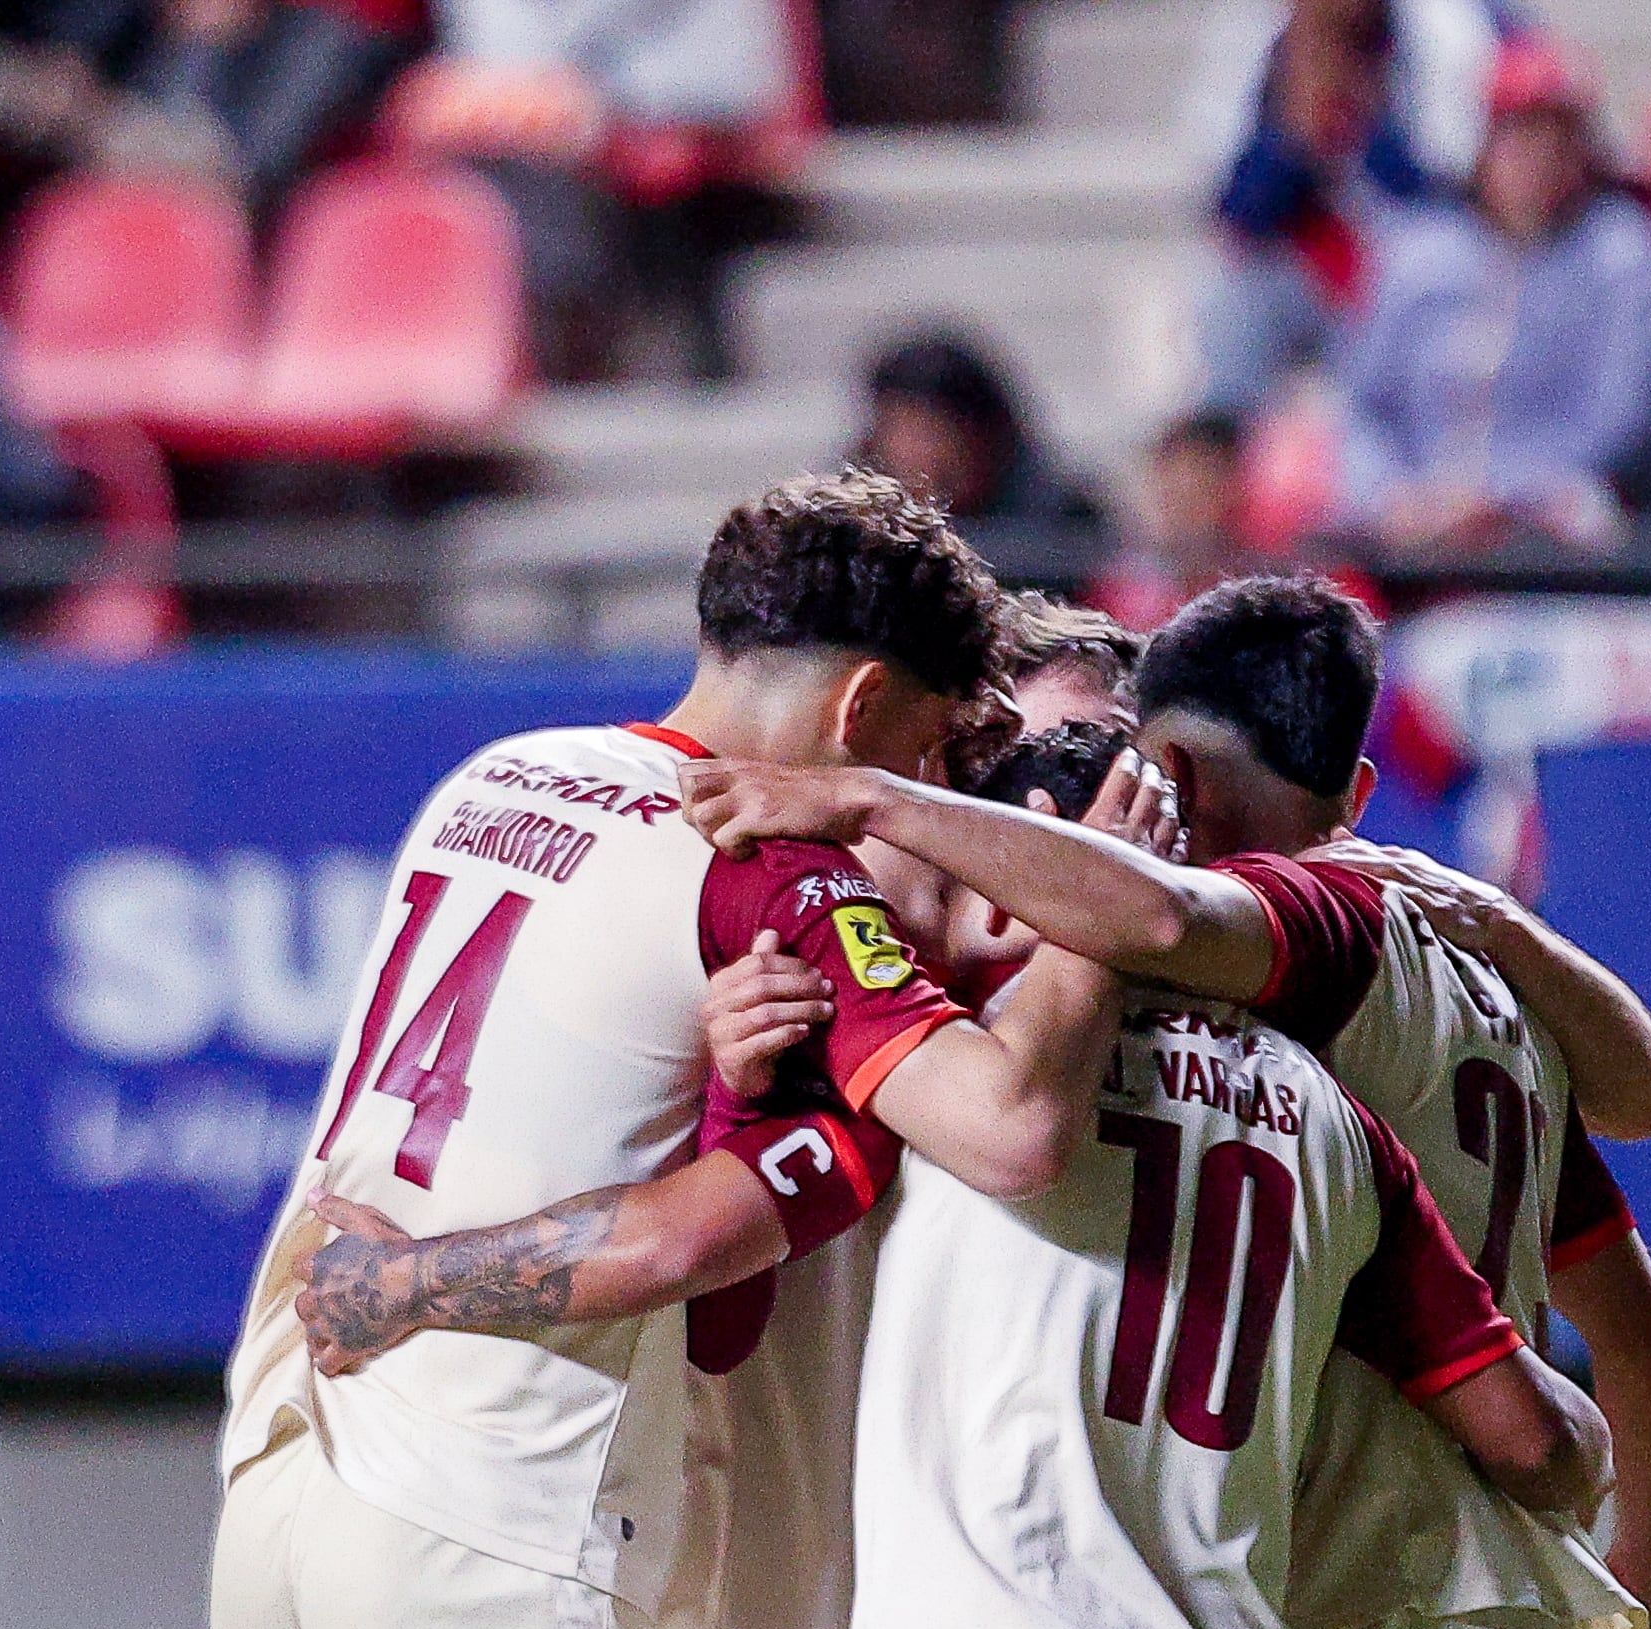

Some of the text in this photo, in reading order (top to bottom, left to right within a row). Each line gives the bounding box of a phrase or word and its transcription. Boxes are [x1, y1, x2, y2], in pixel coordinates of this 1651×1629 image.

[315, 870, 536, 1191] 14
[759, 1126, 834, 1197] C
[1097, 1108, 1296, 1452] 10
